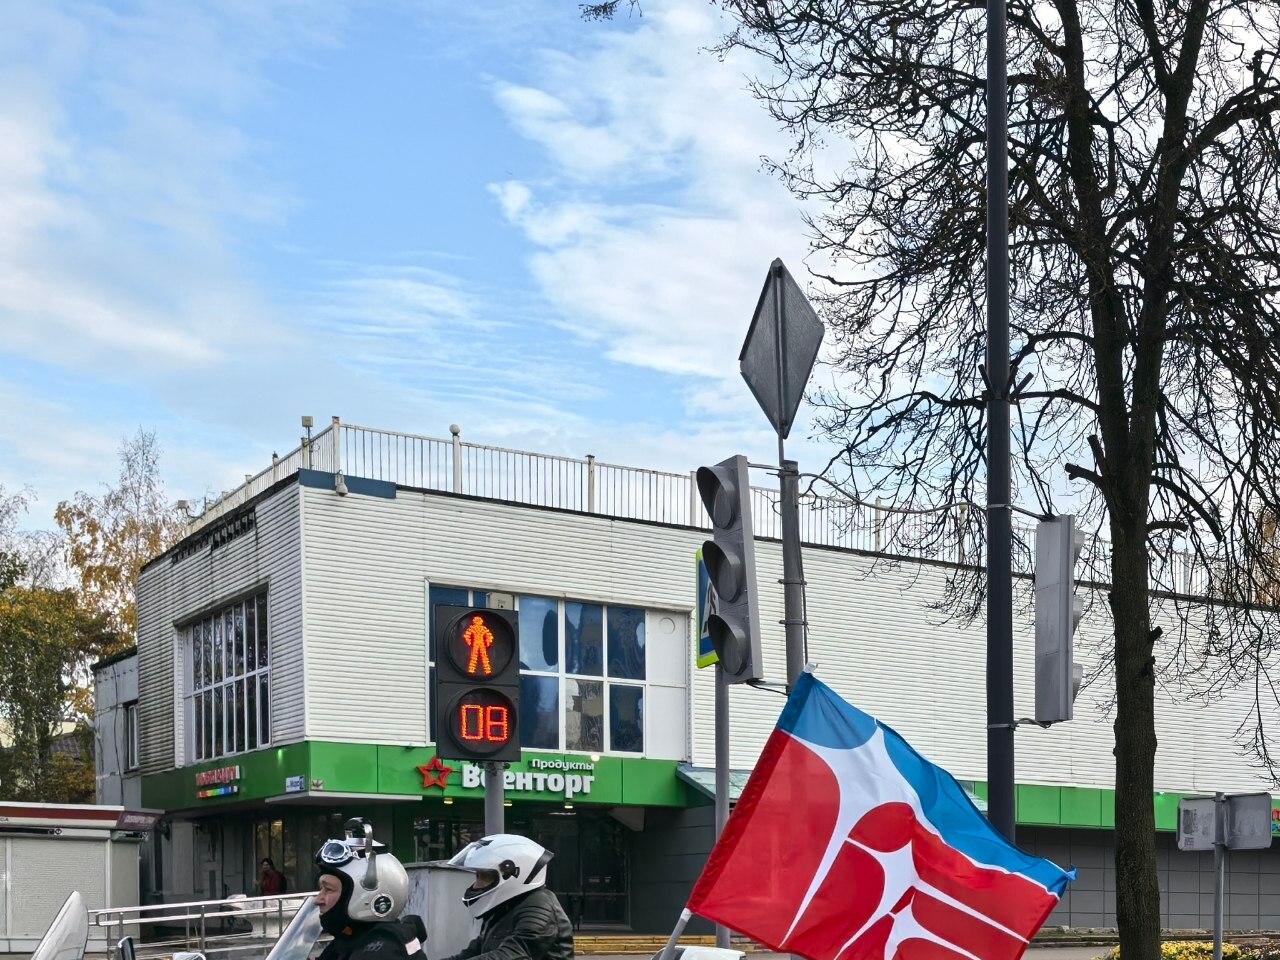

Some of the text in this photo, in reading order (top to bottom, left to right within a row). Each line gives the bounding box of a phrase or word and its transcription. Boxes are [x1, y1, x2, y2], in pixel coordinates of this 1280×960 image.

[461, 704, 508, 741] 08
[461, 763, 595, 799] Венторг
[531, 758, 595, 771] Продукты
